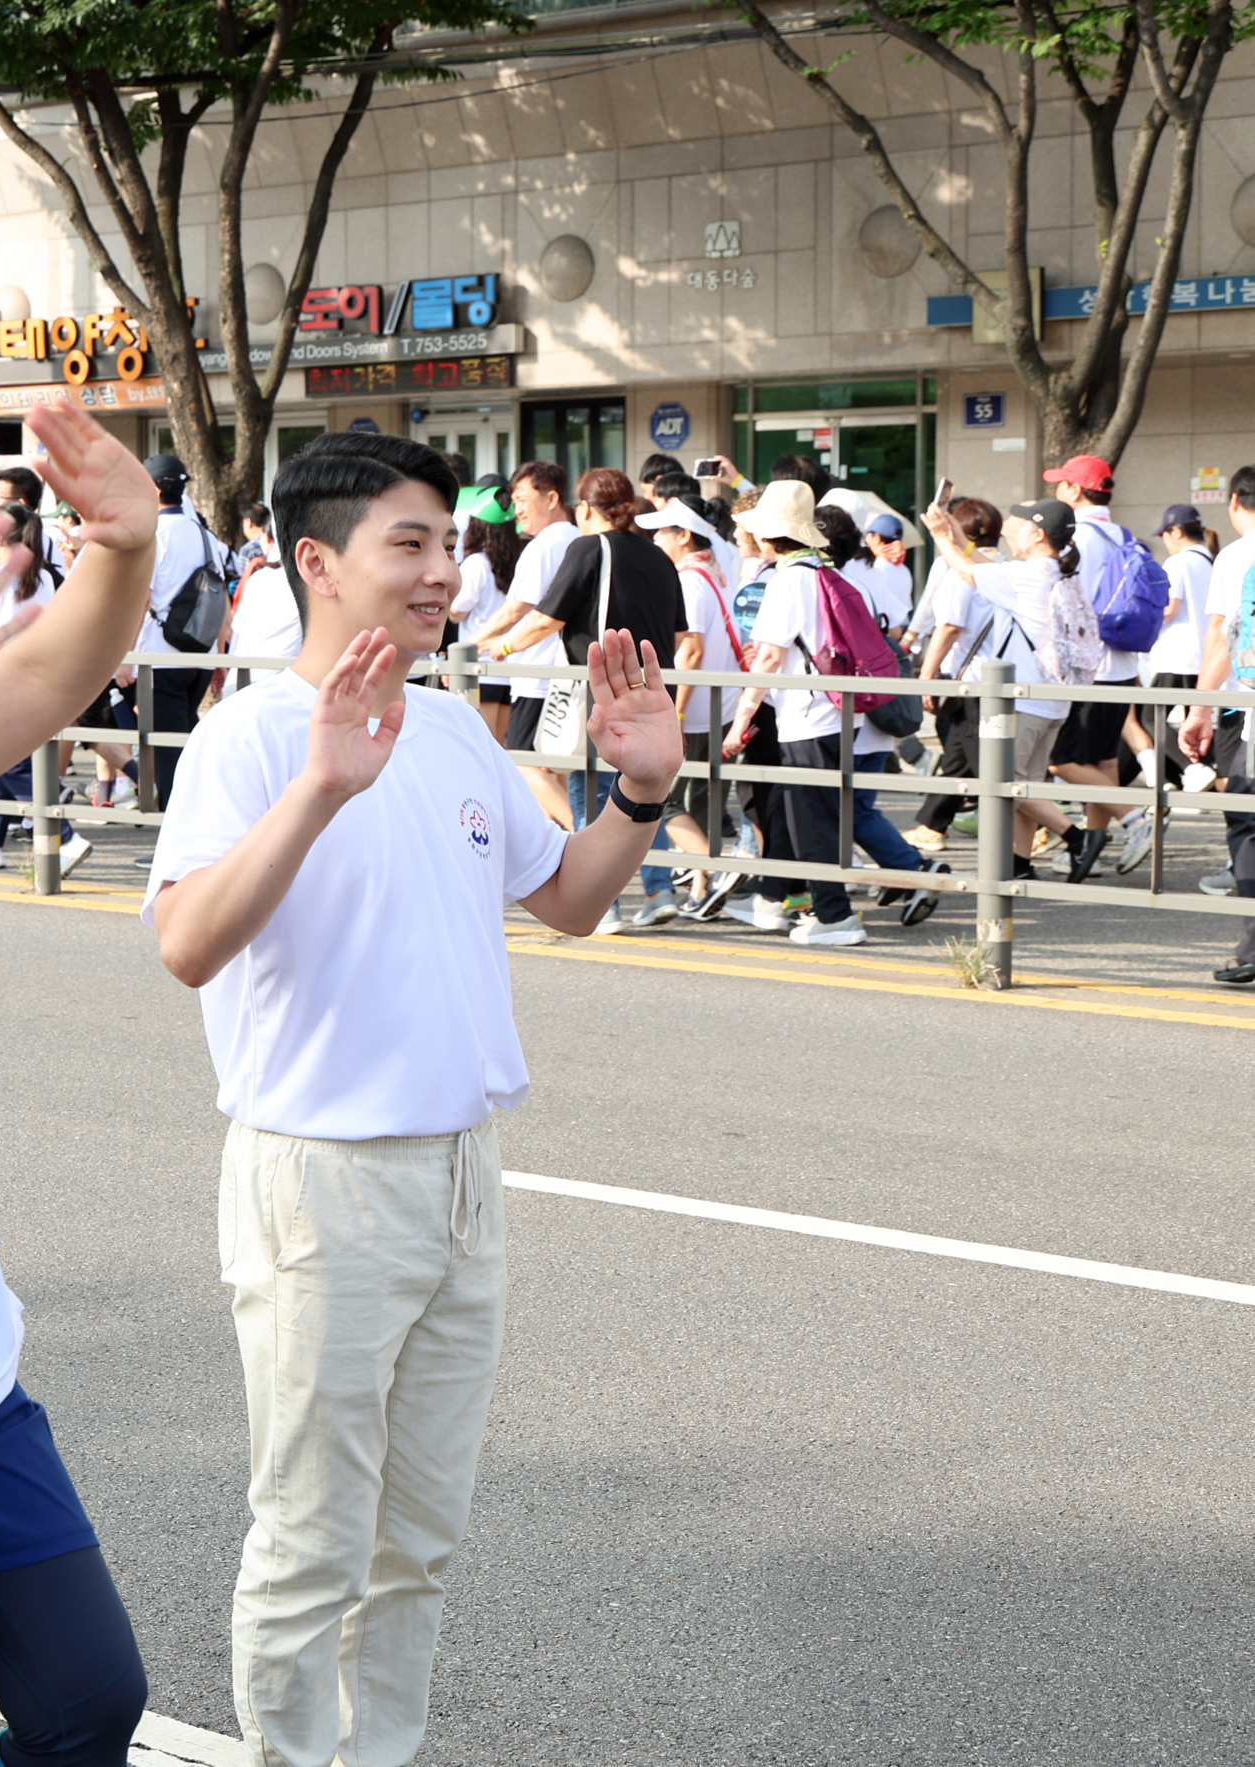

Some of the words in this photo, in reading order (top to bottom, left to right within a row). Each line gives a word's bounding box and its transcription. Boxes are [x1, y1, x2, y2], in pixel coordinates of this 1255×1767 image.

[687, 268, 758, 292] 대동다숲
[301, 273, 495, 335] 도어/몰딩
[290, 345, 305, 360] nd
[306, 343, 342, 359] Doors
[342, 341, 388, 359] System
[400, 333, 488, 356] T.753-5525
[81, 385, 119, 406] 상담
[974, 403, 993, 419] 55
[655, 417, 684, 436] ADT
